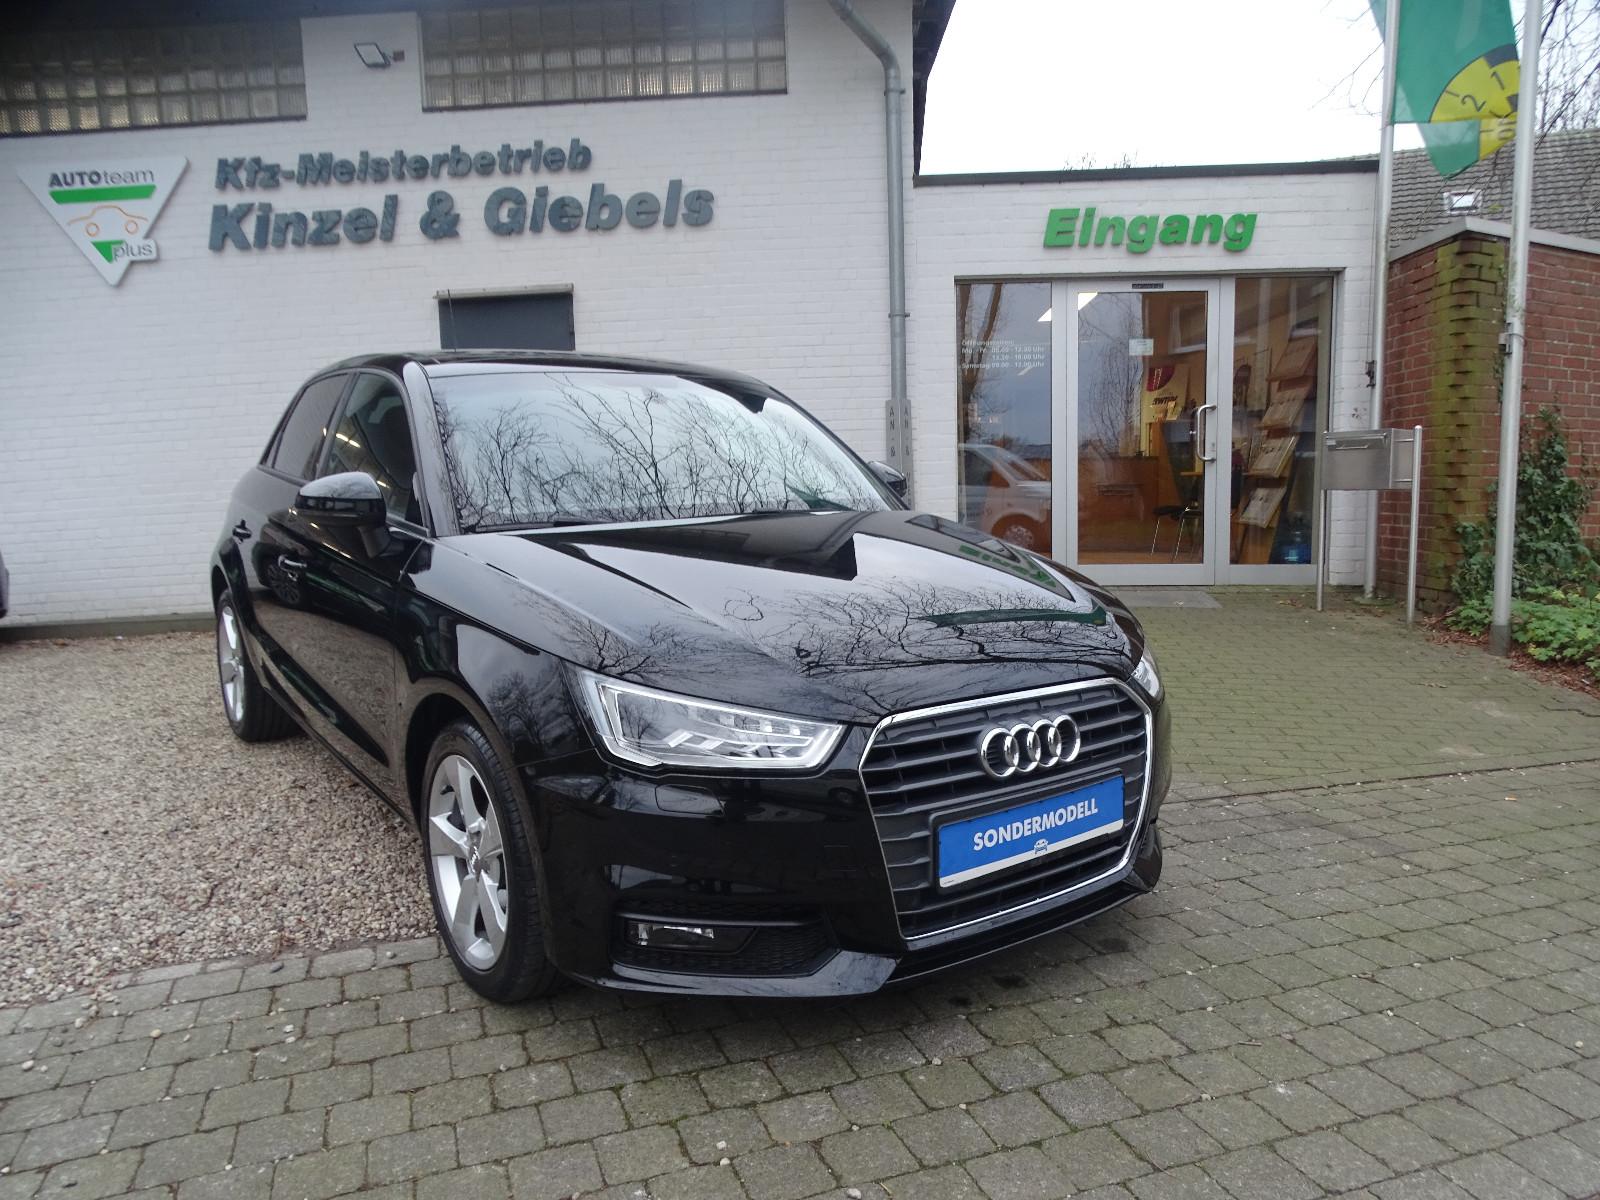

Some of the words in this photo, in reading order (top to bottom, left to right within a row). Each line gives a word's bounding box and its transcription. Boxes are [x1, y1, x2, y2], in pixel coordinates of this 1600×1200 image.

[215, 137, 592, 190] Kfz-Meisterbetrieb
[208, 194, 399, 251] Kinzel
[419, 190, 460, 240] &
[483, 179, 715, 237] Giebels
[1043, 206, 1258, 254] Eingang
[113, 241, 153, 261] plus
[973, 798, 1099, 851] SONDERMODELL
